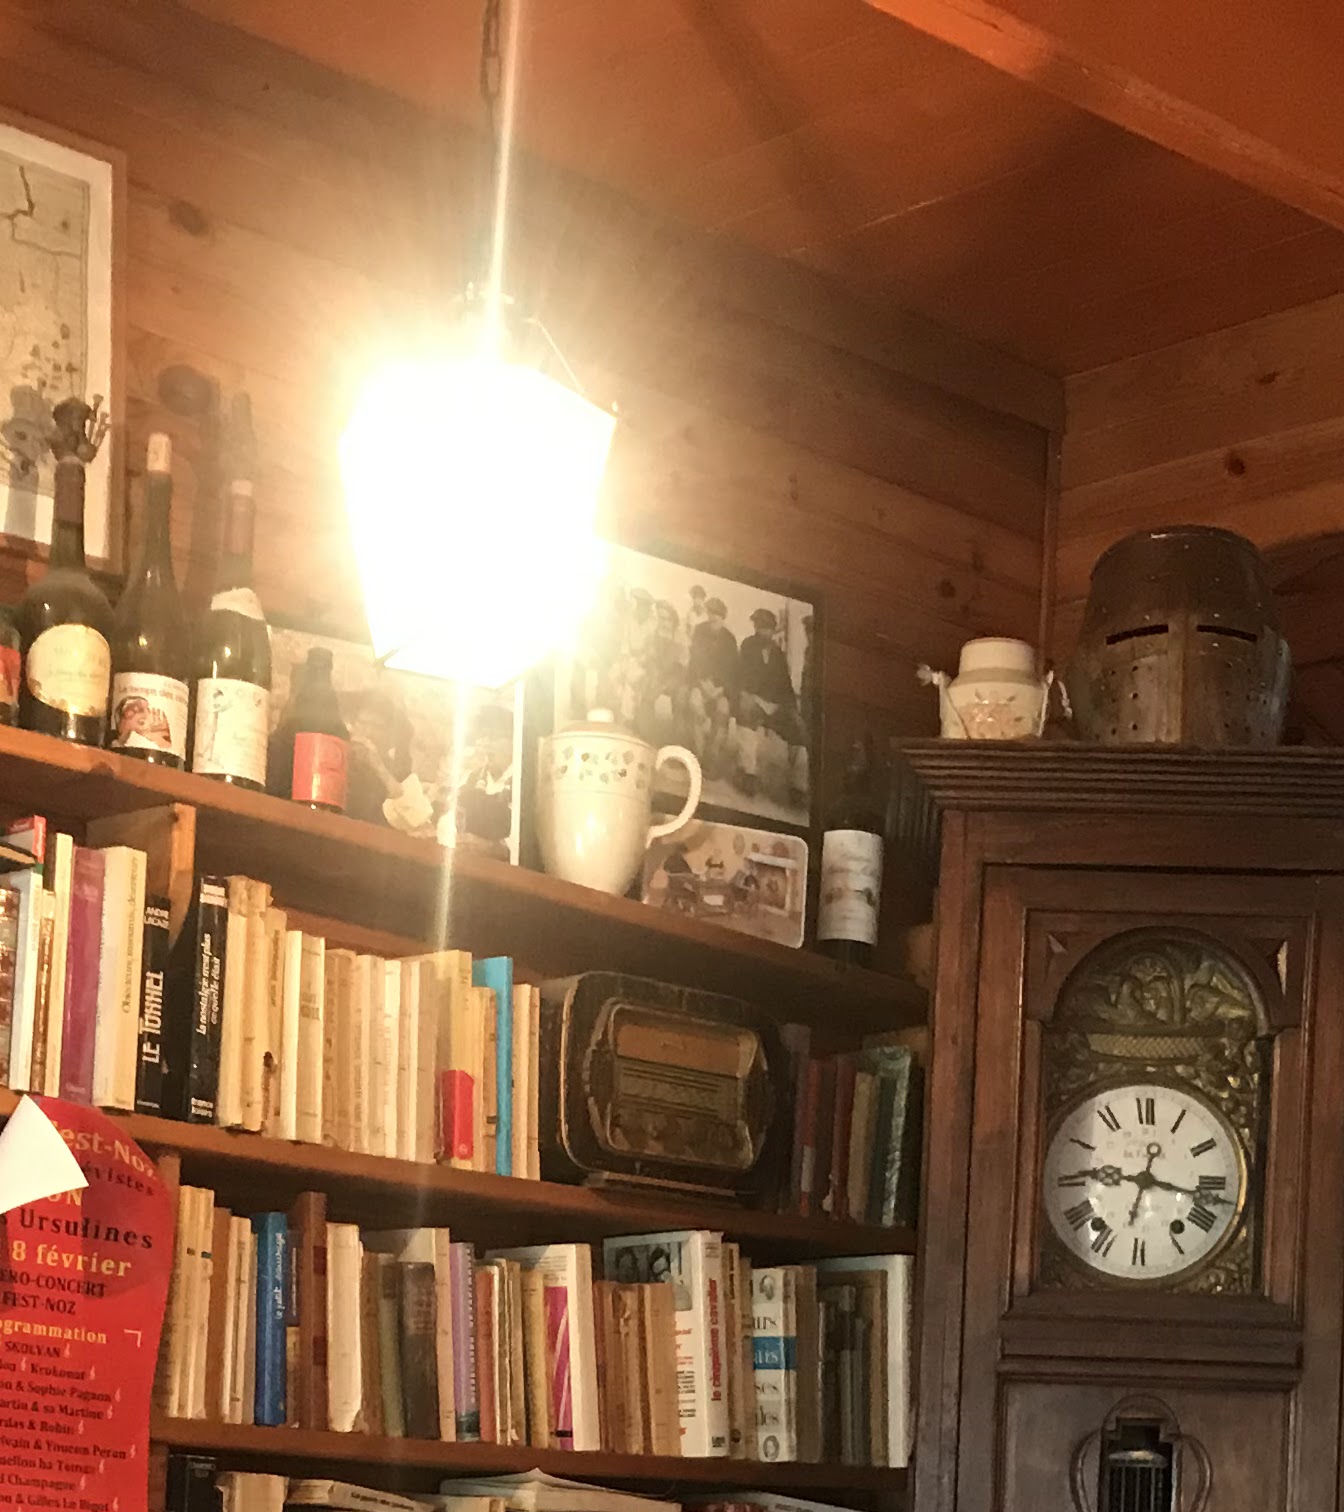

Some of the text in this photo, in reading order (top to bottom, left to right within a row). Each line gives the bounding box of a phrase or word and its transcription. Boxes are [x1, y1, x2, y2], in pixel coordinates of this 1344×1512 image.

[19, 1207, 154, 1250] Ursulines
[12, 1239, 132, 1278] 8 février
